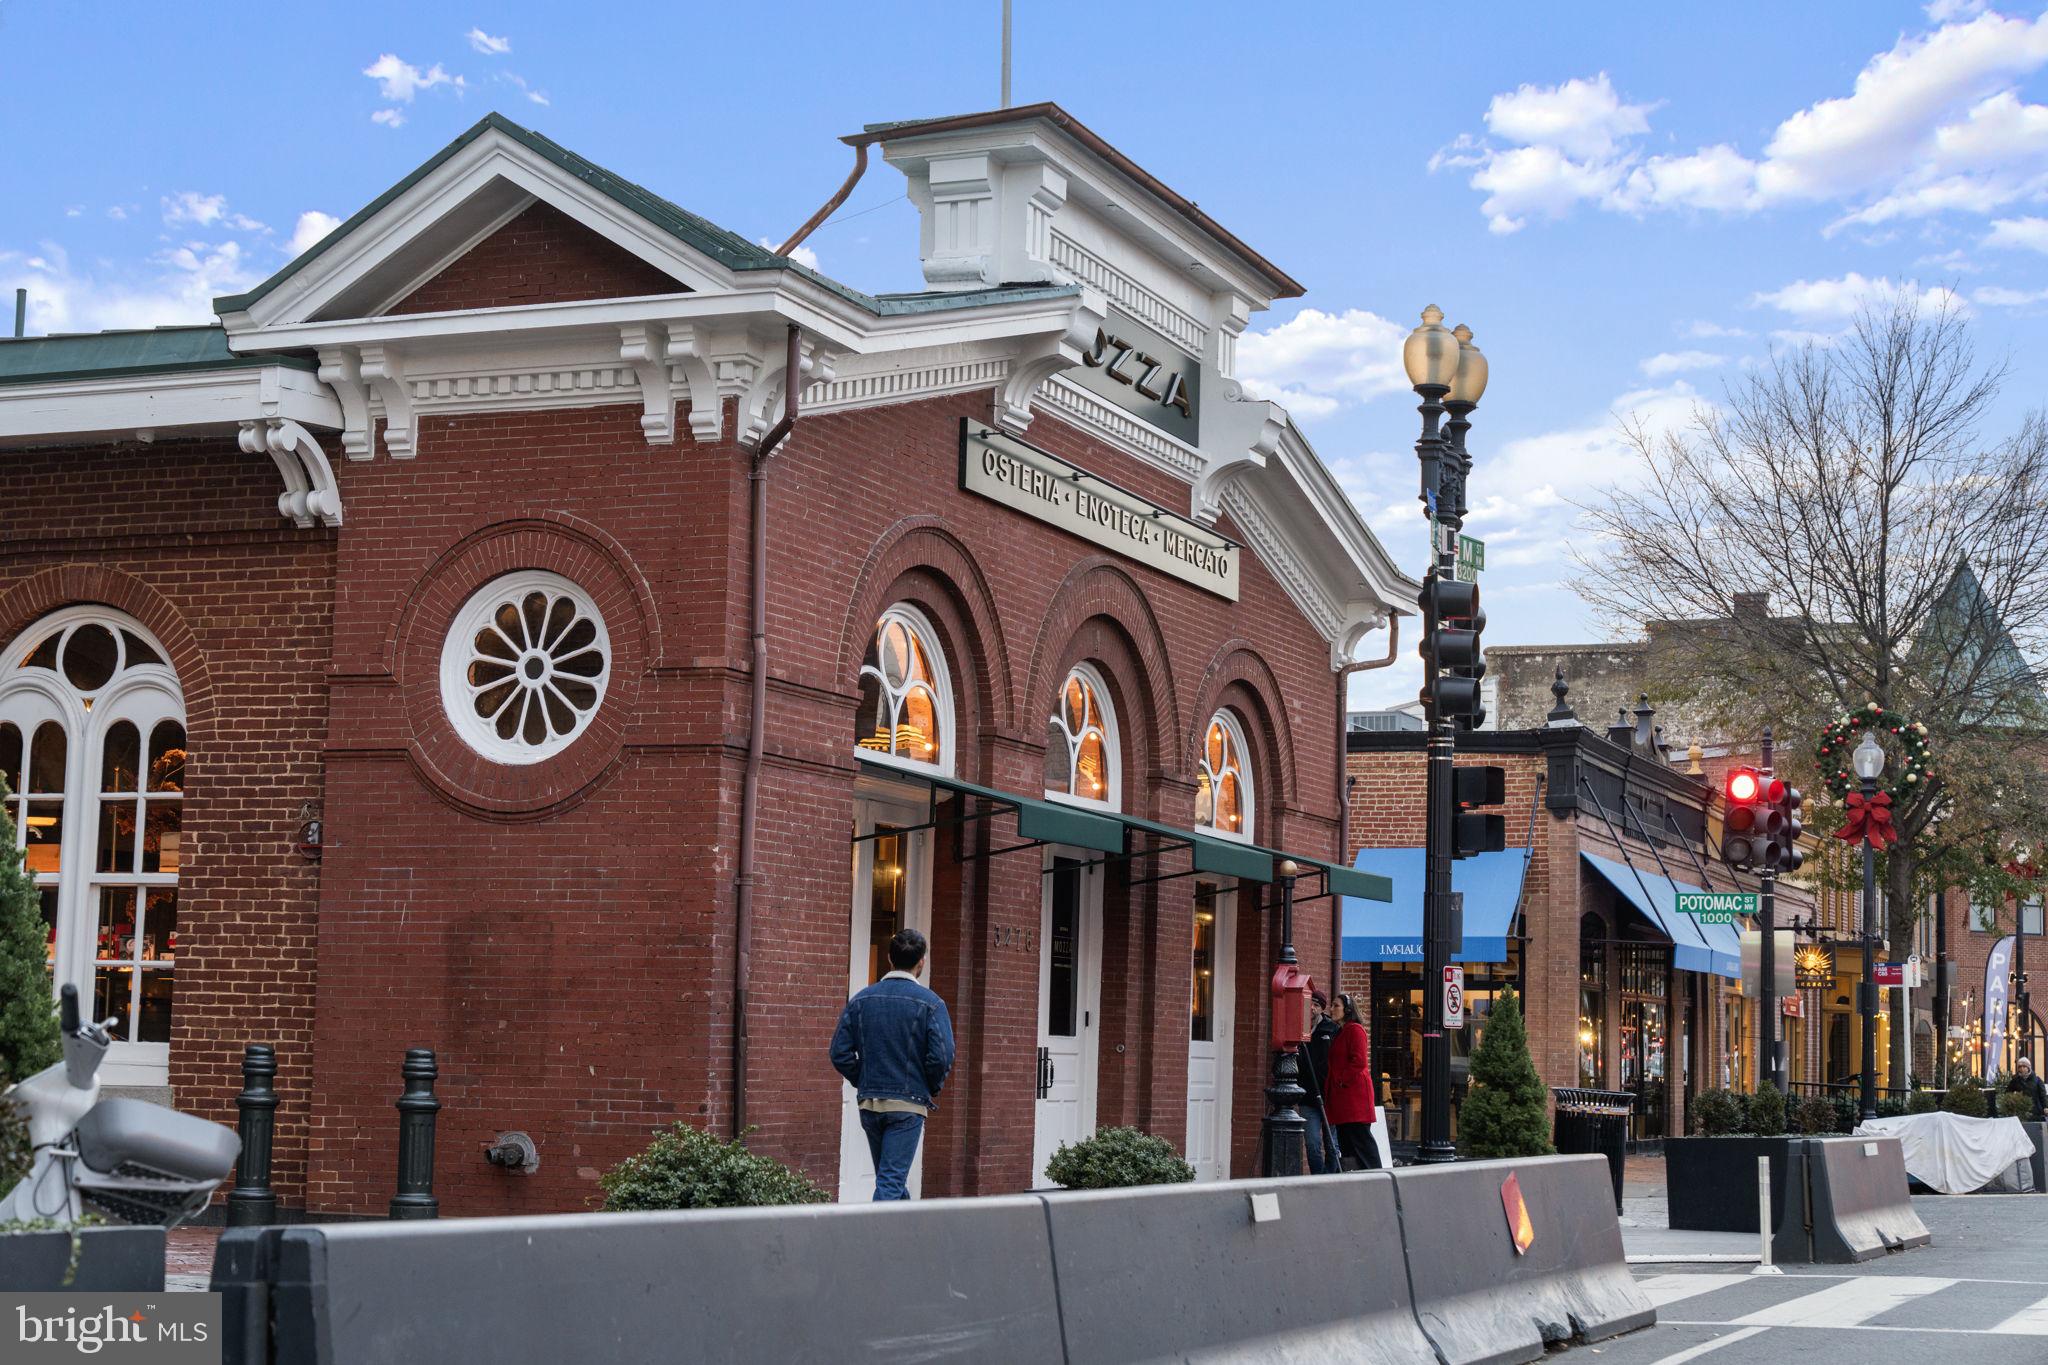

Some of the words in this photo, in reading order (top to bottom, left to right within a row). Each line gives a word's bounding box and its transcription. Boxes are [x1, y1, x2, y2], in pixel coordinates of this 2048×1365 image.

[982, 447, 1061, 506] OSTERIA
[1076, 489, 1150, 544] ENOTECA
[1163, 528, 1229, 579] MERCATO
[1463, 541, 1473, 563] M
[1457, 563, 1477, 582] 3200
[1679, 895, 1742, 911] POTOMAC
[1701, 913, 1732, 924] 1000
